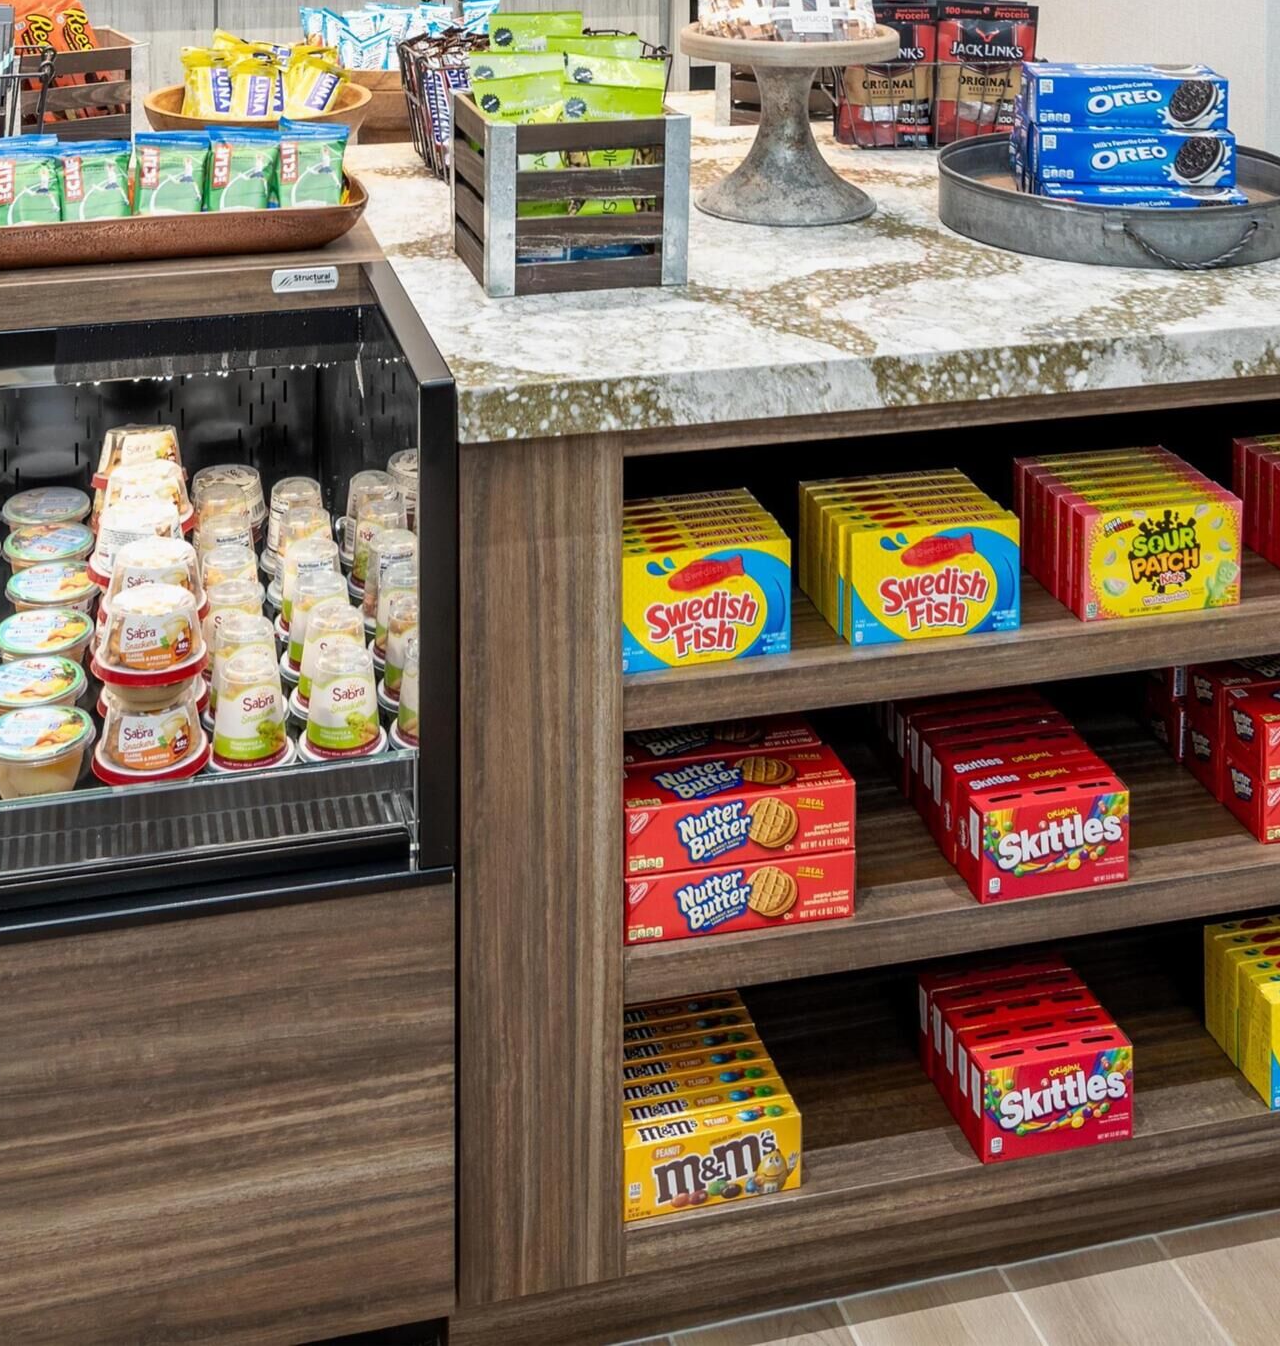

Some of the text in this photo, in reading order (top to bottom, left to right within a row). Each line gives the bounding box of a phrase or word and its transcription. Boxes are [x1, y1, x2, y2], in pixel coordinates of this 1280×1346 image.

[895, 12, 930, 21] Protein
[994, 11, 1030, 20] Protein
[950, 42, 983, 57] JACK
[253, 76, 265, 113] LUNA
[313, 73, 338, 105] LUNA
[1088, 89, 1162, 114] OREO
[1092, 146, 1168, 171] OREO
[294, 272, 331, 282] Structural
[1132, 526, 1196, 558] SOUR
[1131, 548, 1200, 581] PATCH
[880, 566, 988, 614] Swedish
[647, 591, 758, 640] Swedish
[906, 595, 966, 629] Fish
[127, 627, 157, 641] Sabra
[672, 620, 736, 656] Fish
[243, 693, 275, 712] Sabra
[333, 686, 365, 702] Sabra
[124, 726, 155, 741] Sabra
[655, 760, 725, 789] Nutter
[953, 757, 1004, 774] Skittles
[673, 768, 741, 799] Butter
[969, 773, 1020, 790] Skittles
[804, 799, 825, 807] REAL
[678, 801, 742, 843] Nutter
[686, 815, 752, 861] Butter
[998, 814, 1122, 870] Skittles
[804, 868, 824, 876] REAL
[677, 871, 742, 911] Nutter
[687, 885, 751, 930] Butter
[687, 1077, 710, 1086] PEANUT
[696, 1095, 720, 1106] PEANUT
[999, 1070, 1126, 1129] Skittles
[705, 1115, 730, 1127] PEANUT
[655, 1146, 681, 1159] PEANUT
[653, 1132, 776, 1204] m&m's
